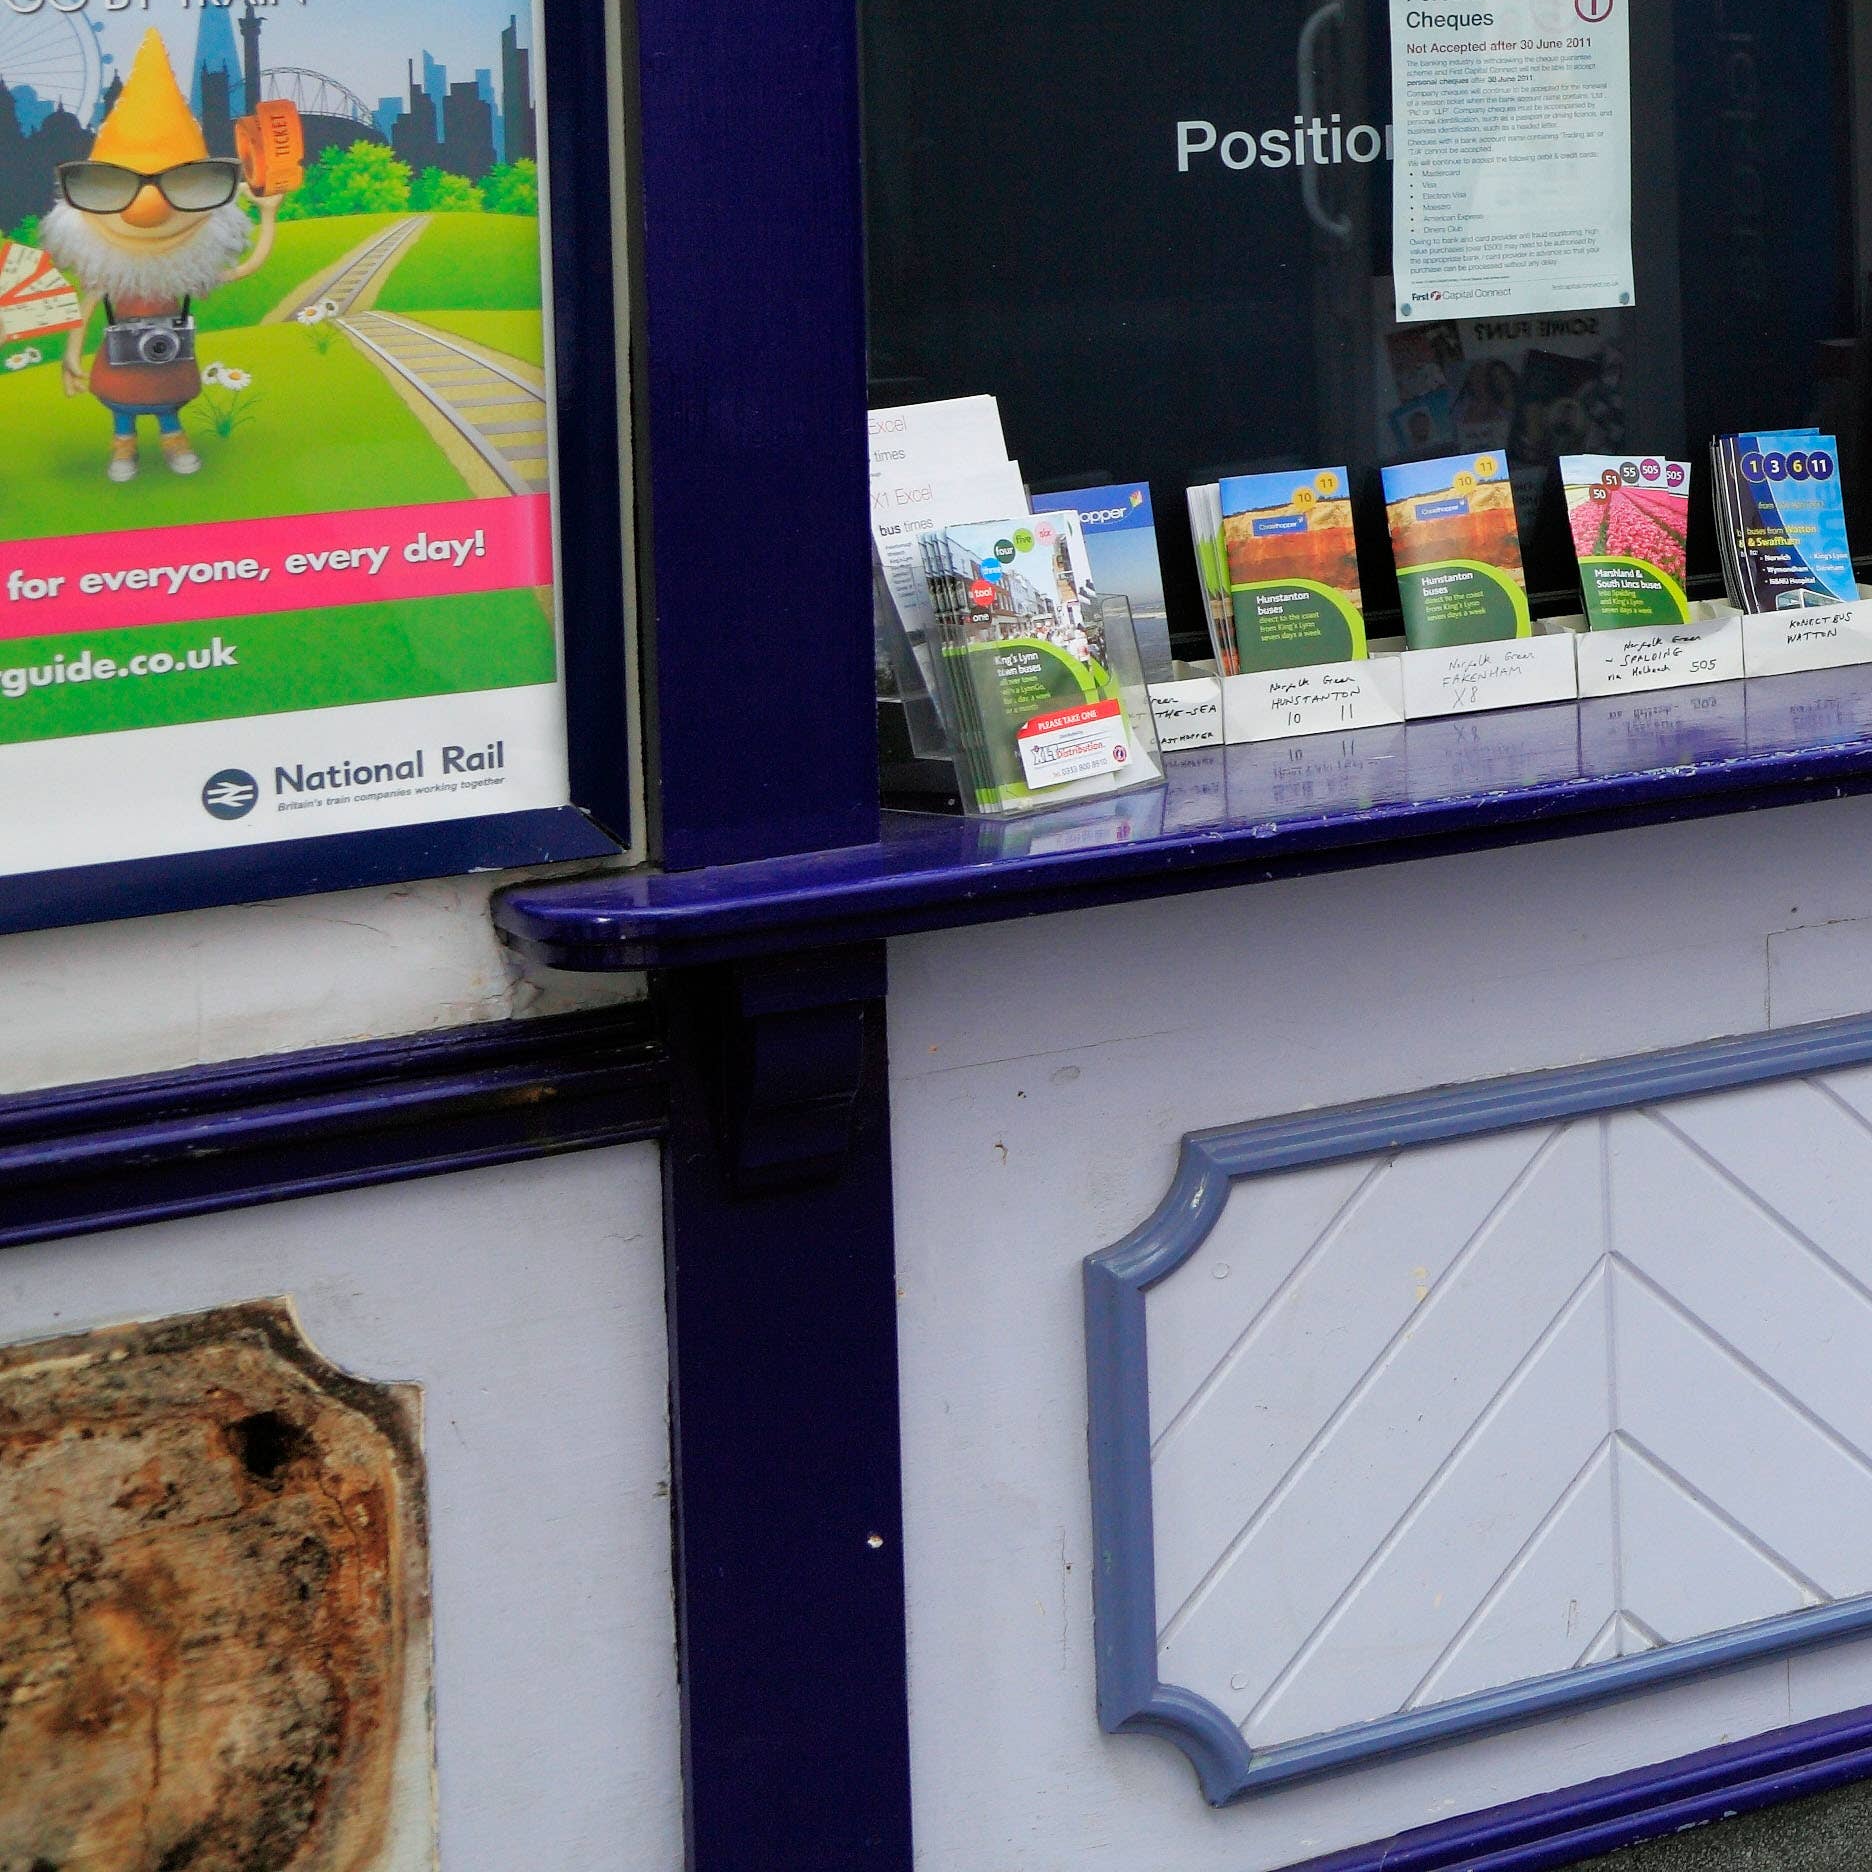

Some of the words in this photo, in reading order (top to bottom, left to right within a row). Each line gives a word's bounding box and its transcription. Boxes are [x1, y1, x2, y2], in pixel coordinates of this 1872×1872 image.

[1406, 12, 1494, 30] Cheques
[1407, 44, 1427, 54] Not
[1431, 41, 1486, 55] Accepted
[1490, 40, 1516, 52] after
[1520, 39, 1533, 49] 30
[1537, 38, 1562, 50] June
[1567, 37, 1591, 48] 2011
[270, 114, 290, 158] TICKET
[1176, 113, 1394, 172] Positio
[1412, 292, 1429, 301] First
[1443, 290, 1473, 301] Capital
[1475, 288, 1511, 298] Connect
[1623, 466, 1636, 476] 55
[1642, 465, 1659, 474] 505
[1750, 461, 1758, 472] 1
[1771, 462, 1780, 473] 3
[1793, 461, 1802, 472] 6
[1811, 460, 1827, 472] 11
[1320, 479, 1333, 489] 11
[1606, 475, 1618, 485] 51
[896, 485, 933, 505] Excel
[1298, 493, 1311, 504] 10
[1594, 489, 1606, 499] 50
[880, 524, 900, 536] bus
[904, 518, 933, 533] times
[1016, 535, 1031, 544] five
[996, 547, 1013, 556] four
[7, 569, 66, 601] for
[79, 554, 272, 596] everyone,
[284, 539, 391, 577] every
[404, 529, 487, 566] day!
[1422, 572, 1473, 586] Hunstanton
[1595, 569, 1634, 578] Marshland
[1597, 580, 1620, 589] South
[1622, 580, 1640, 589] Lincs
[1641, 581, 1662, 589] buses
[1423, 586, 1448, 596] buses
[1257, 592, 1310, 604] Hunstanton
[1258, 606, 1283, 615] buses
[973, 614, 989, 622] one
[0, 637, 240, 697] guide.co.uk
[1690, 659, 1717, 672] 505
[1272, 687, 1360, 709] HUNSTANTON
[1038, 719, 1063, 730] PLEASE
[1062, 714, 1080, 724] TAKE
[1081, 710, 1097, 720] ONE
[275, 749, 424, 795] National
[442, 741, 504, 774] Rail
[278, 800, 323, 812] Britain's
[327, 796, 351, 806] train
[354, 789, 412, 802] companies
[415, 782, 457, 796] working
[461, 777, 505, 789] together
